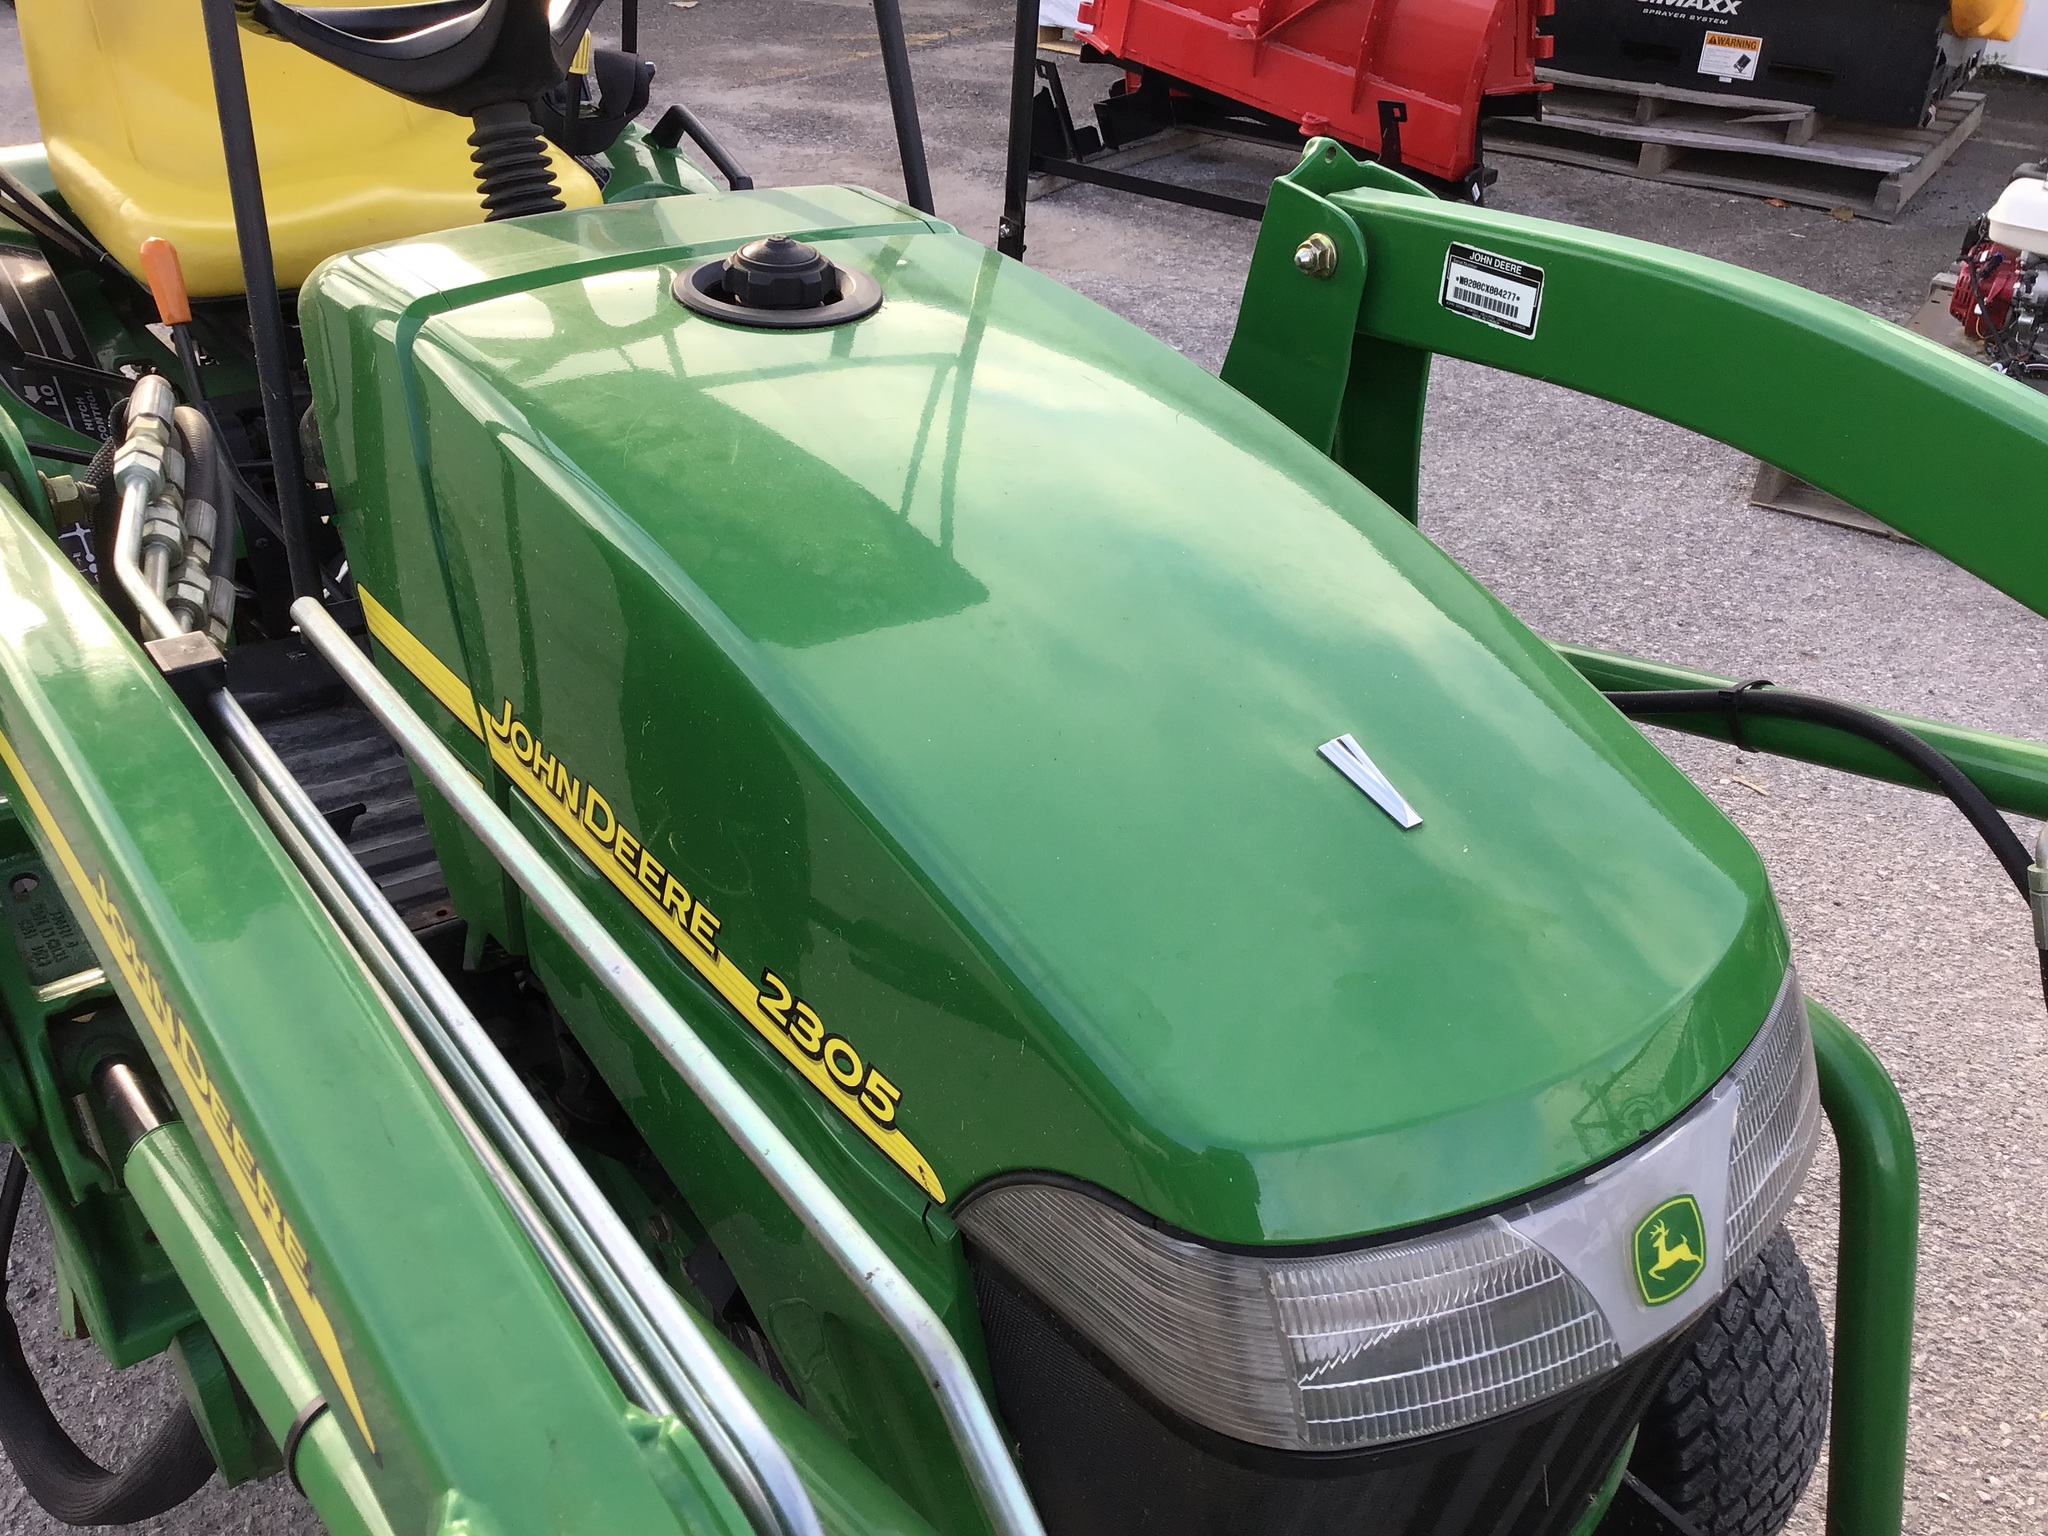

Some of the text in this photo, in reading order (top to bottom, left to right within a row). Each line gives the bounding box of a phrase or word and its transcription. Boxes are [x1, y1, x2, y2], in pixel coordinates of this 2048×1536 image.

[1642, 8, 1729, 25] SPRAYER SYSTEM
[1718, 36, 1757, 50] WARNING
[1469, 252, 1523, 275] JOHN DEERE
[40, 384, 58, 406] LO
[76, 396, 94, 431] HITCH
[85, 388, 109, 441] CONTROL
[491, 699, 901, 1125] JOHN DEERE 2305
[94, 873, 308, 1270] JOHN DEERE
